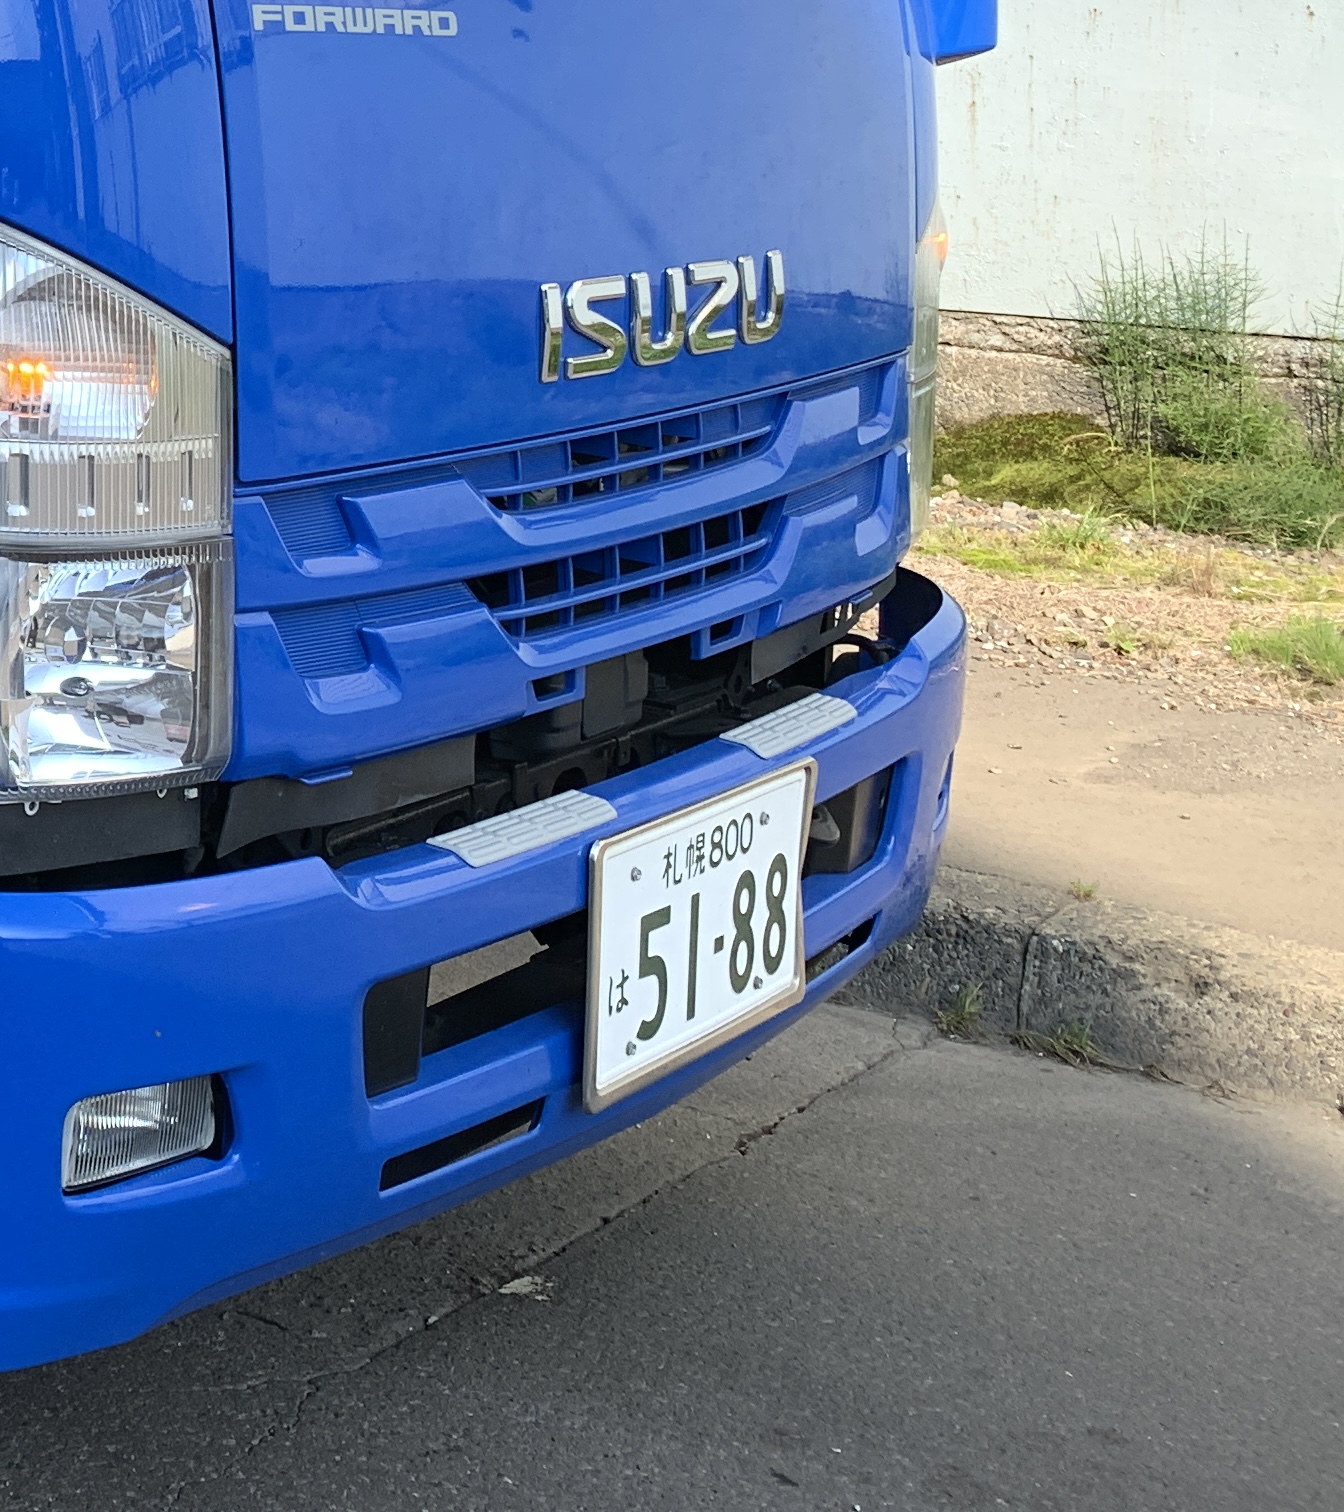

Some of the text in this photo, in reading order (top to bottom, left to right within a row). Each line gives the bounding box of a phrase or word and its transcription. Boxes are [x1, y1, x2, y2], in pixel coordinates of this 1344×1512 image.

[252, 3, 458, 38] FORWARD
[539, 248, 786, 385] ISUZU
[608, 853, 788, 1042] は 51-88
